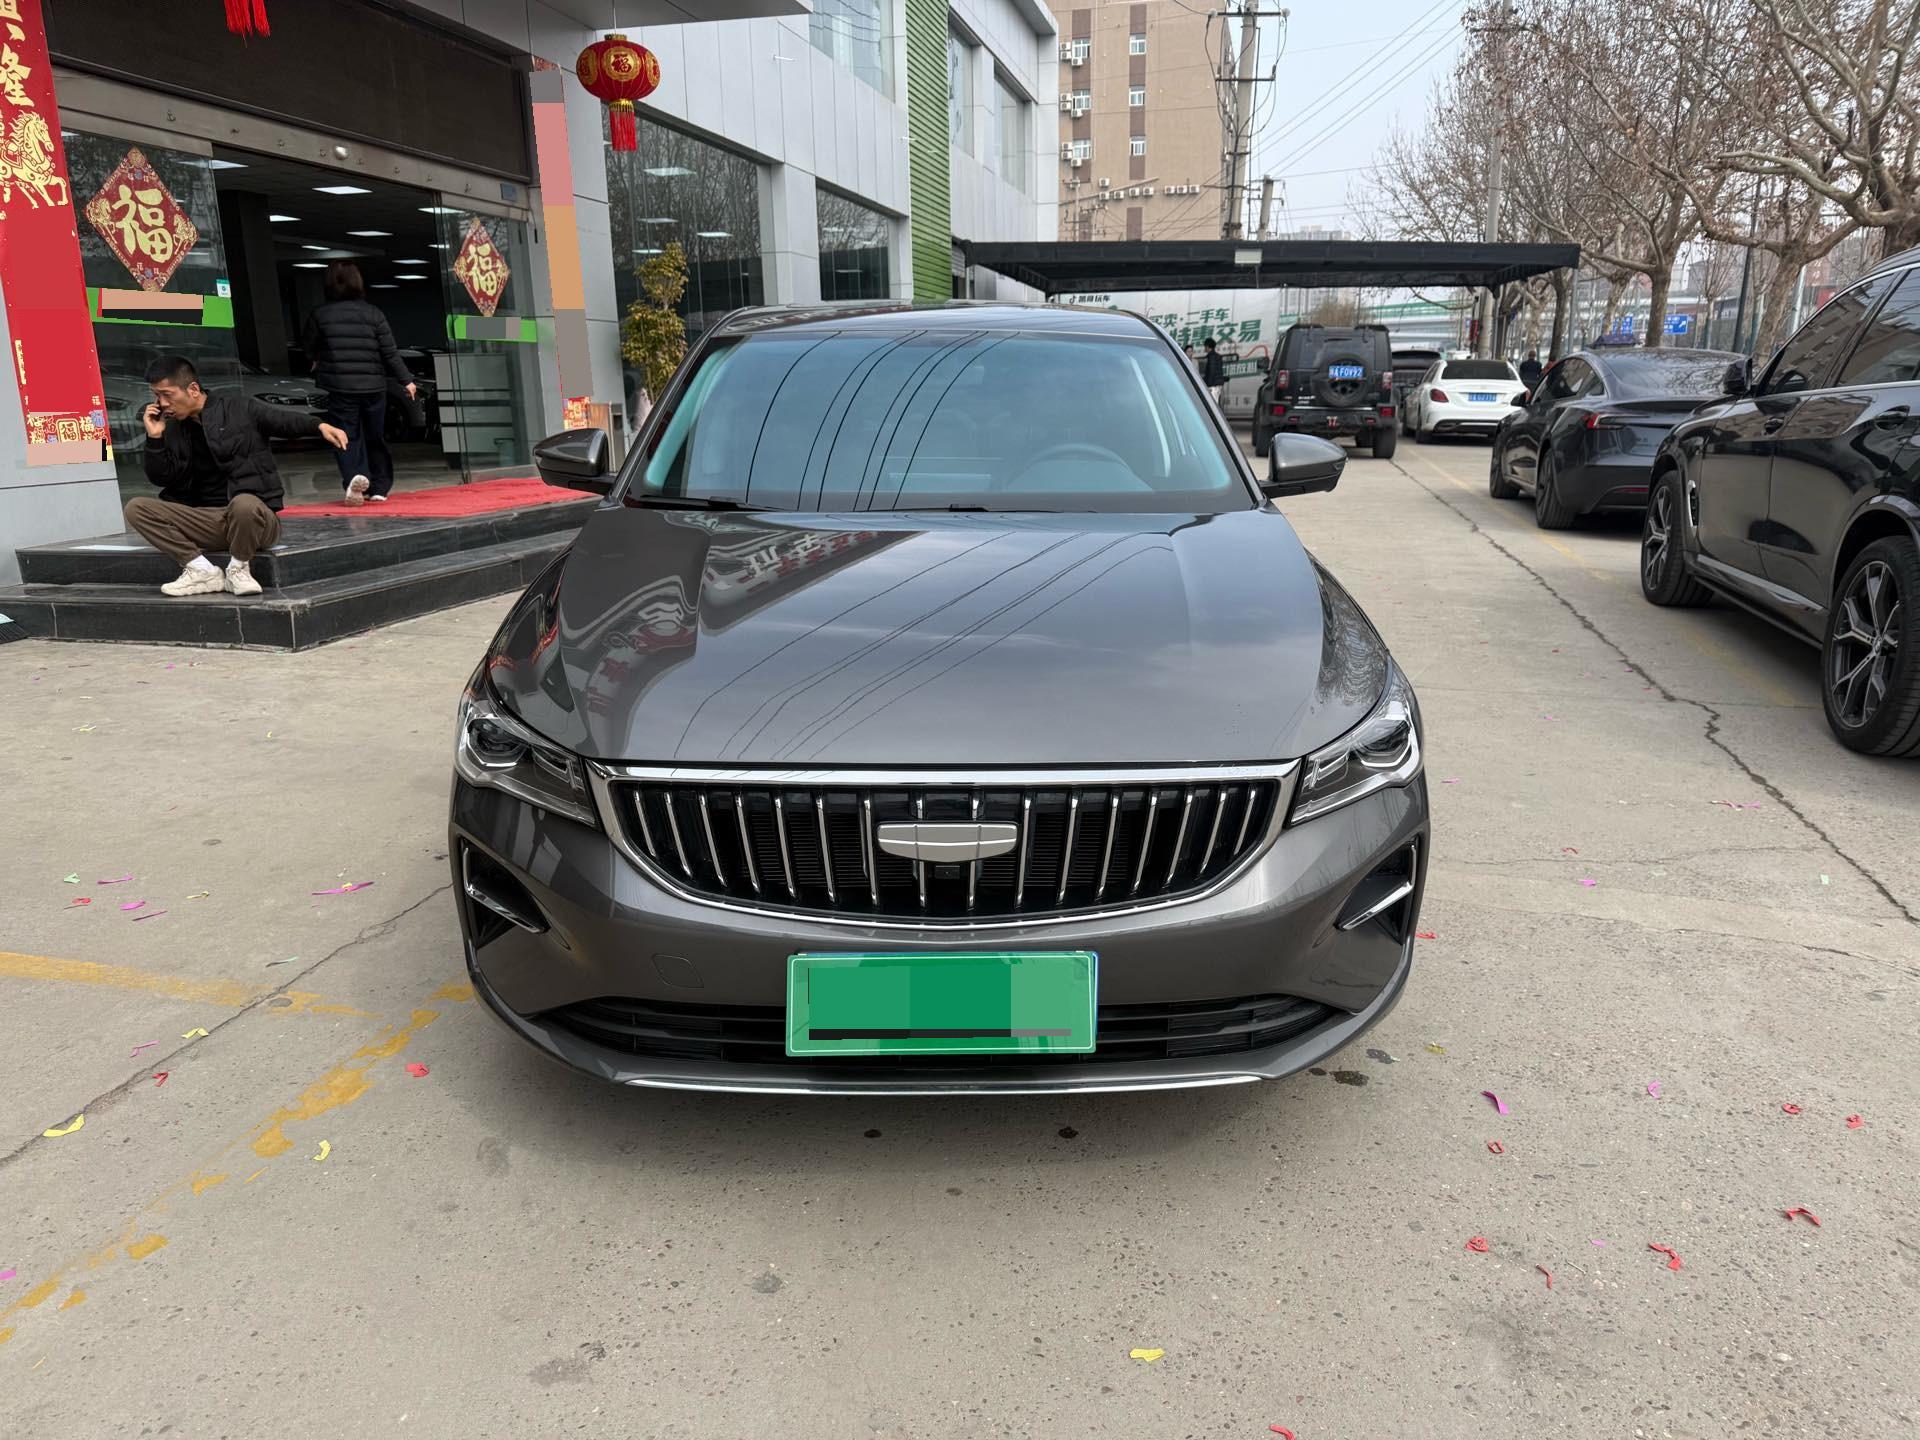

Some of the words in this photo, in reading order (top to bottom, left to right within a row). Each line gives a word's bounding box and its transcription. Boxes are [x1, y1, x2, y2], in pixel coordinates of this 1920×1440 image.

[611, 53, 632, 73] 福
[112, 184, 173, 263] 福
[467, 243, 498, 296] 福
